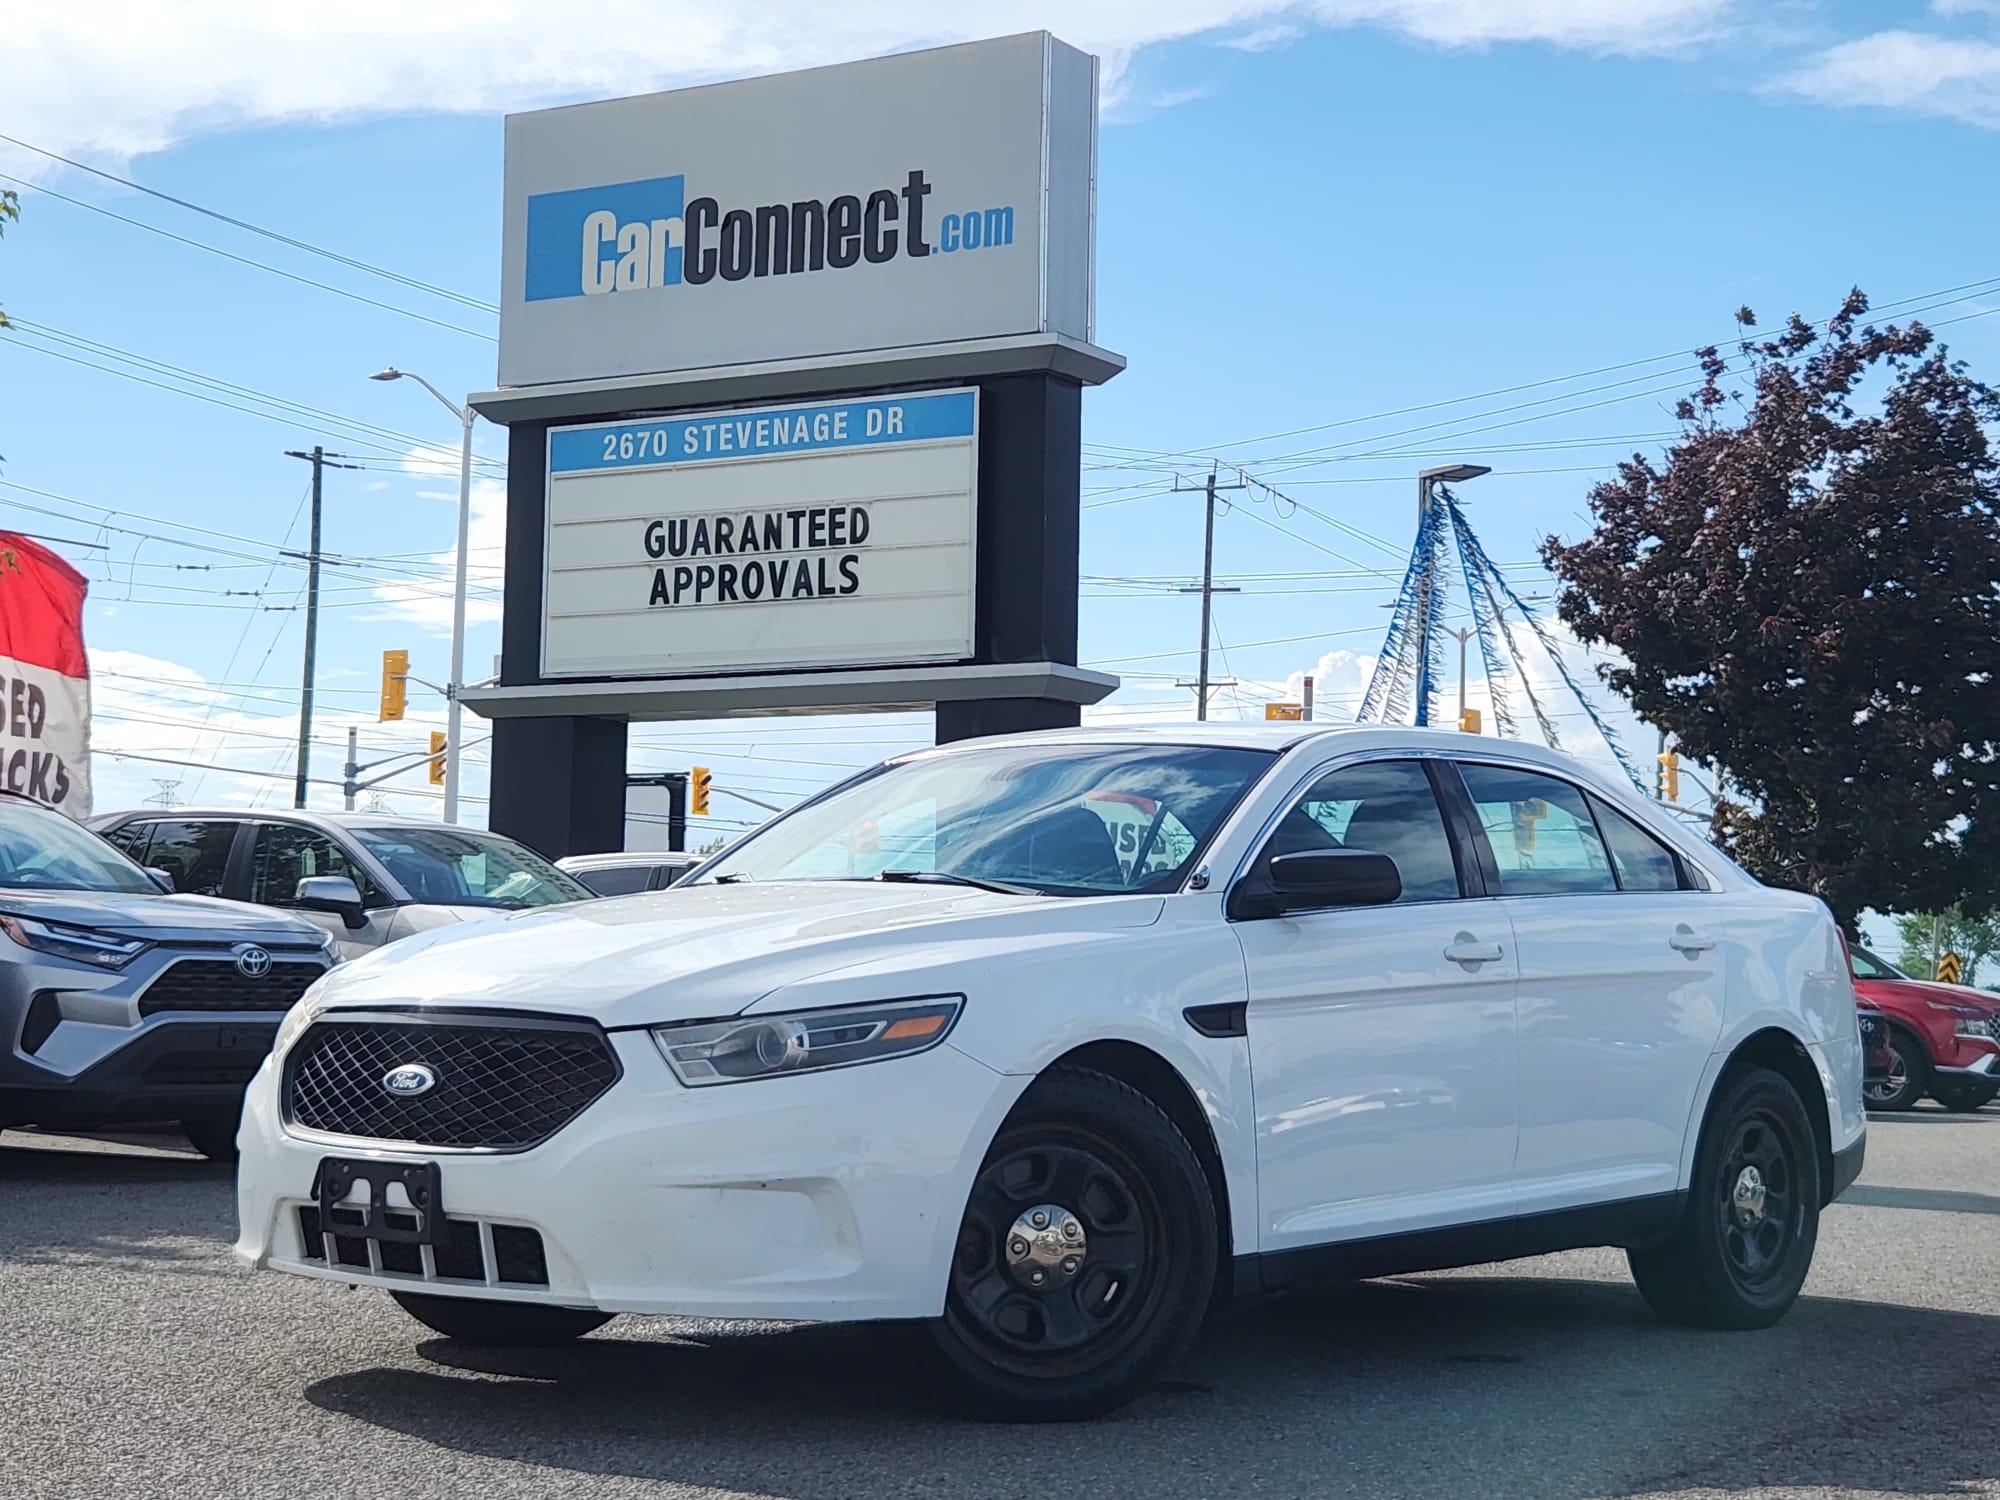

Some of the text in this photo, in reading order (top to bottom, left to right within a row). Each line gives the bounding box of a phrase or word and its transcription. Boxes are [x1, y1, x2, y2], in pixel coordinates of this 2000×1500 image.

[603, 406, 905, 460] 2670 STEVENAGE DR
[644, 506, 870, 559] GUARANTEED
[649, 554, 859, 605] APPROVALS
[0, 747, 70, 804] CKS
[392, 1071, 421, 1088] Ford
